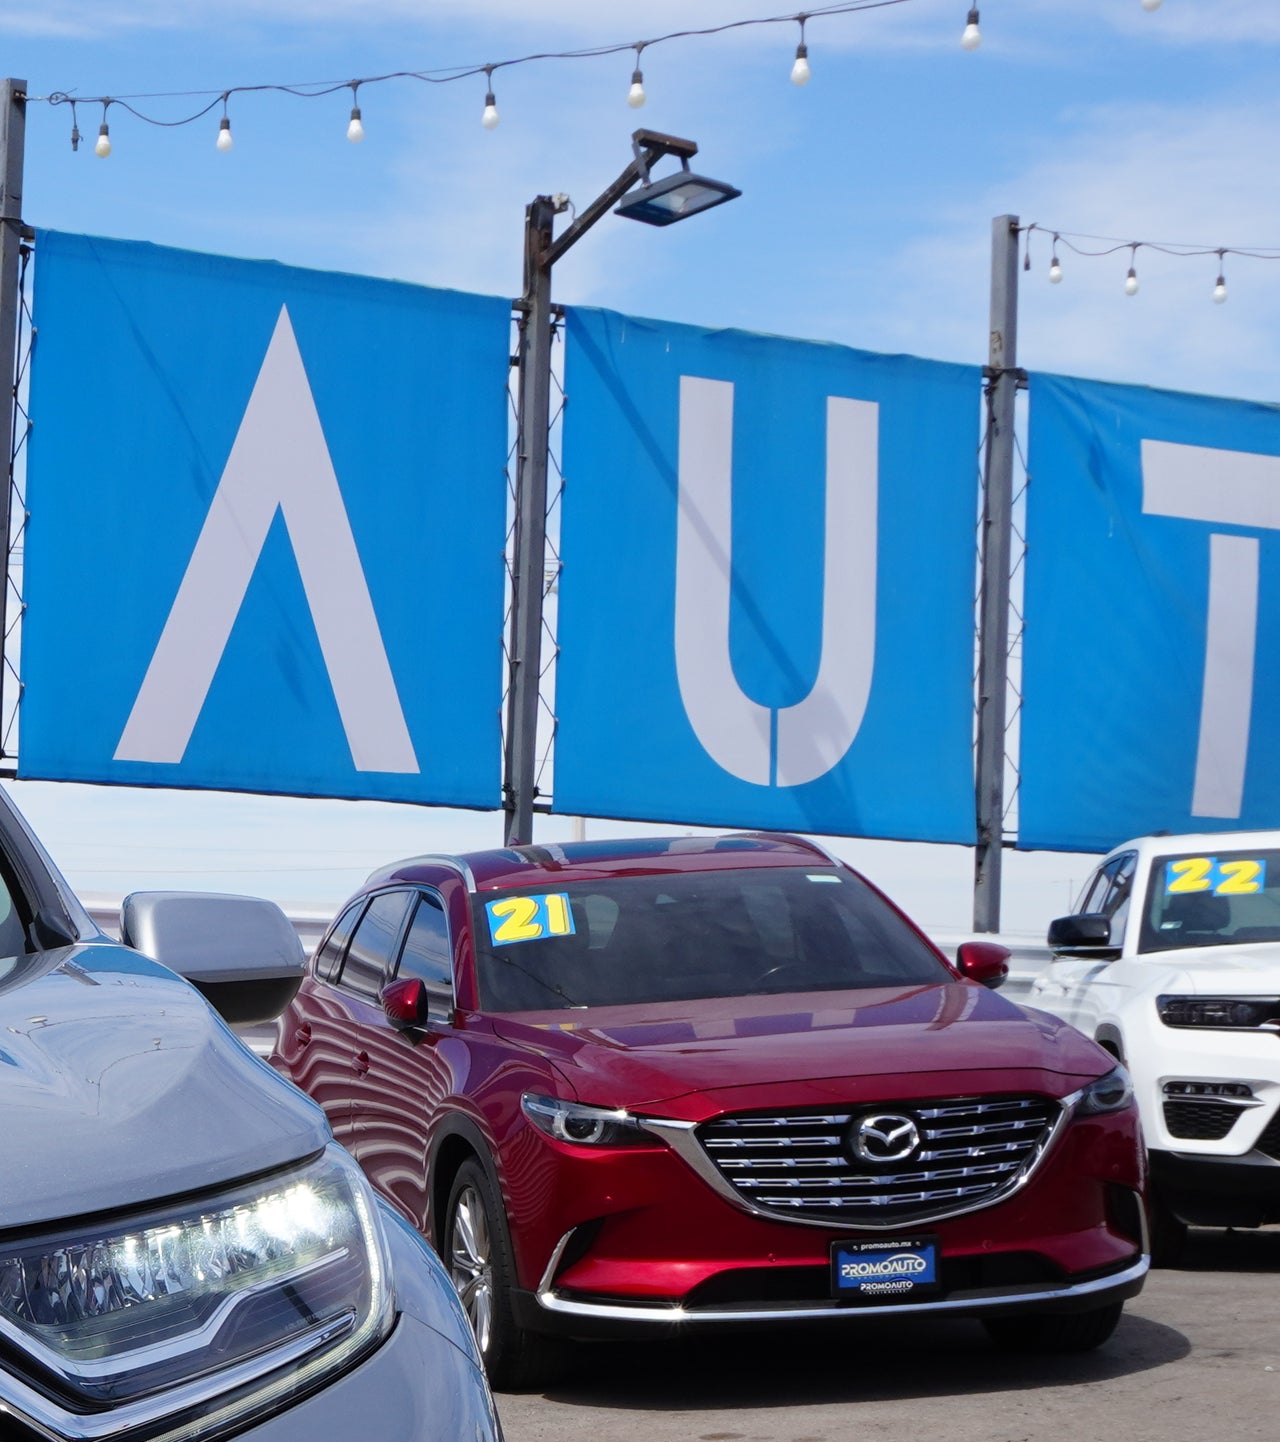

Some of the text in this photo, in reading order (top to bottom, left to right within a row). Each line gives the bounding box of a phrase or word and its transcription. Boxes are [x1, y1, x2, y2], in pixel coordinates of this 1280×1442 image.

[1168, 858, 1261, 894] 22
[491, 894, 571, 941] 21
[860, 1241, 912, 1251] promoauto.mx
[841, 1259, 926, 1276] PROMOAUTO
[860, 1280, 913, 1291] PROMOAUTO
